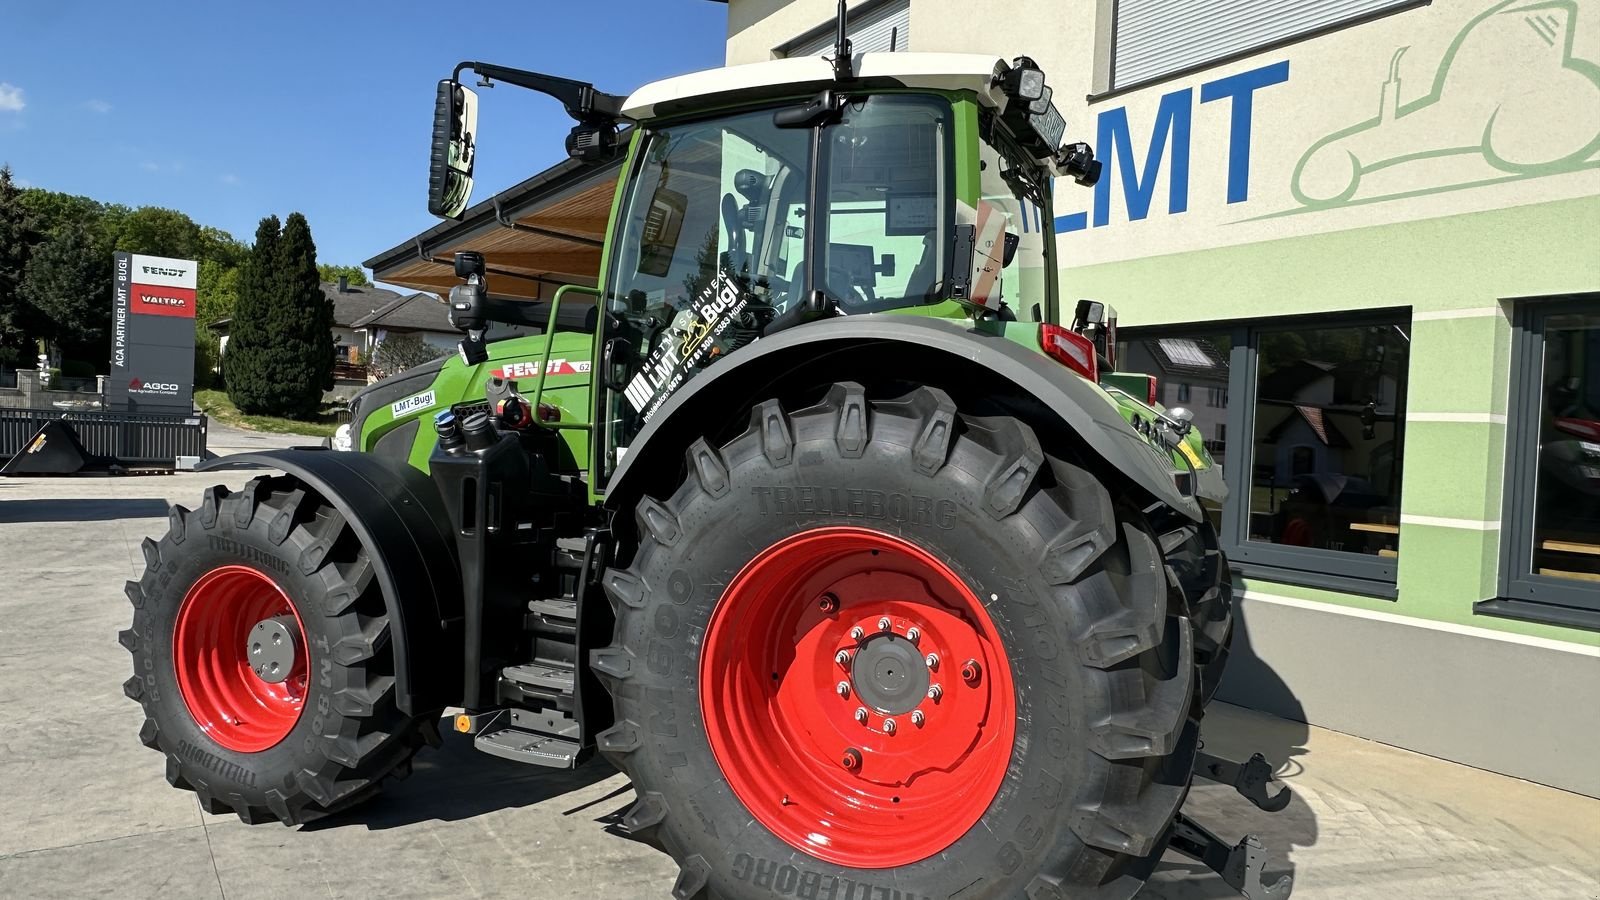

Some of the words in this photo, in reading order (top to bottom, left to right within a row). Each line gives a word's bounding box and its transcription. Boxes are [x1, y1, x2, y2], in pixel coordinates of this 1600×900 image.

[118, 257, 128, 281] BUGL
[142, 265, 187, 278] FENDT
[118, 287, 127, 307] LMT
[141, 295, 186, 307] VALTRA
[116, 308, 126, 346] PARTNER
[648, 346, 681, 390] LMT
[700, 277, 740, 324] Bugl
[115, 348, 126, 367] ACA
[142, 382, 179, 391] AGCO
[394, 392, 433, 413] LMT-Bugl
[751, 485, 958, 530] TRELLEBORG
